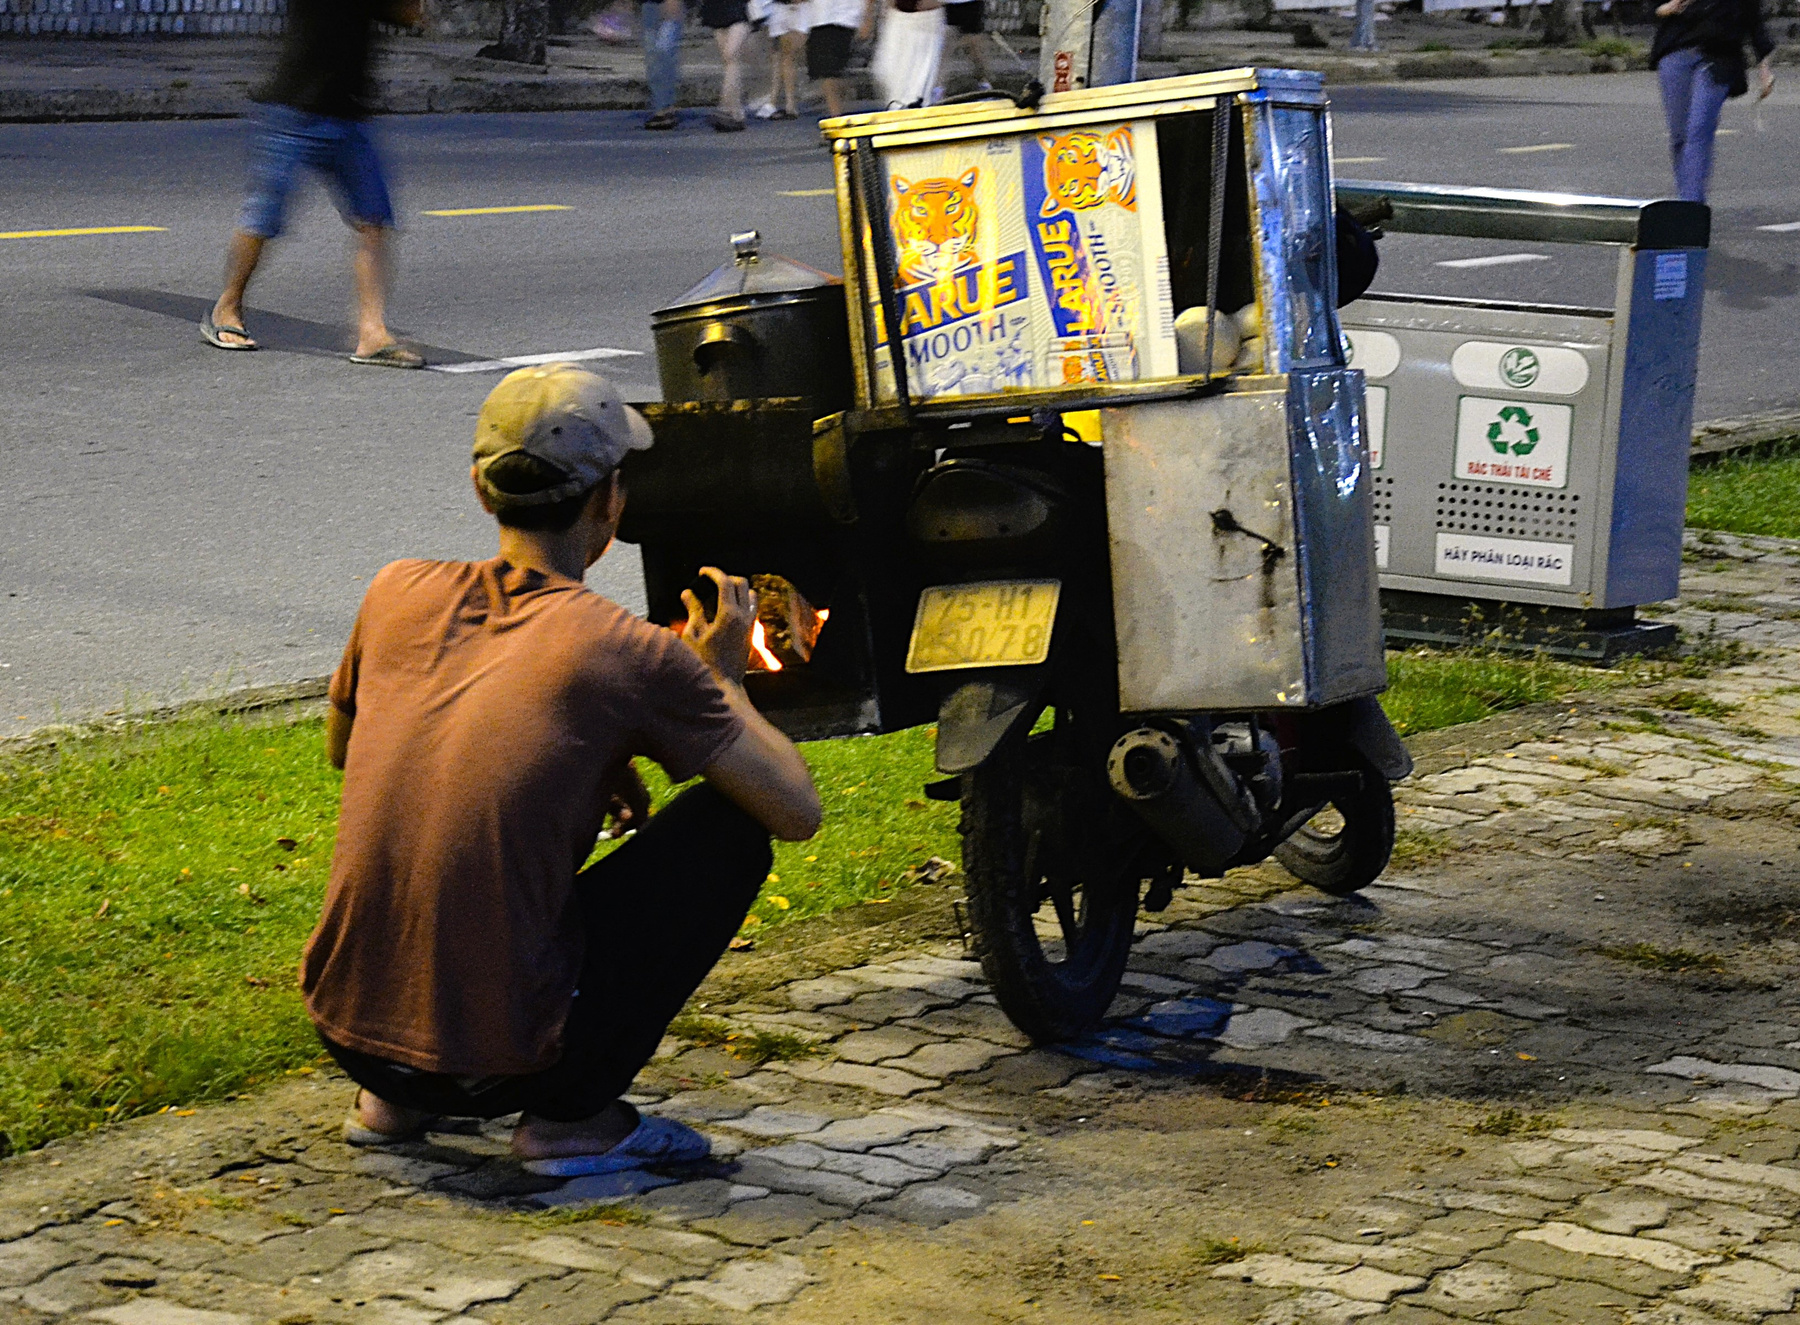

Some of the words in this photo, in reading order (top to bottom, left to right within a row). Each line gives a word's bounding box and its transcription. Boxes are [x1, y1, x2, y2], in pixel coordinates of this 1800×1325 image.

[1037, 219, 1095, 334] LARUE
[1088, 233, 1125, 314] SMOOTH
[909, 313, 1006, 368] MOOTH
[1467, 460, 1488, 475] RÁC
[1537, 554, 1563, 570] RÁC
